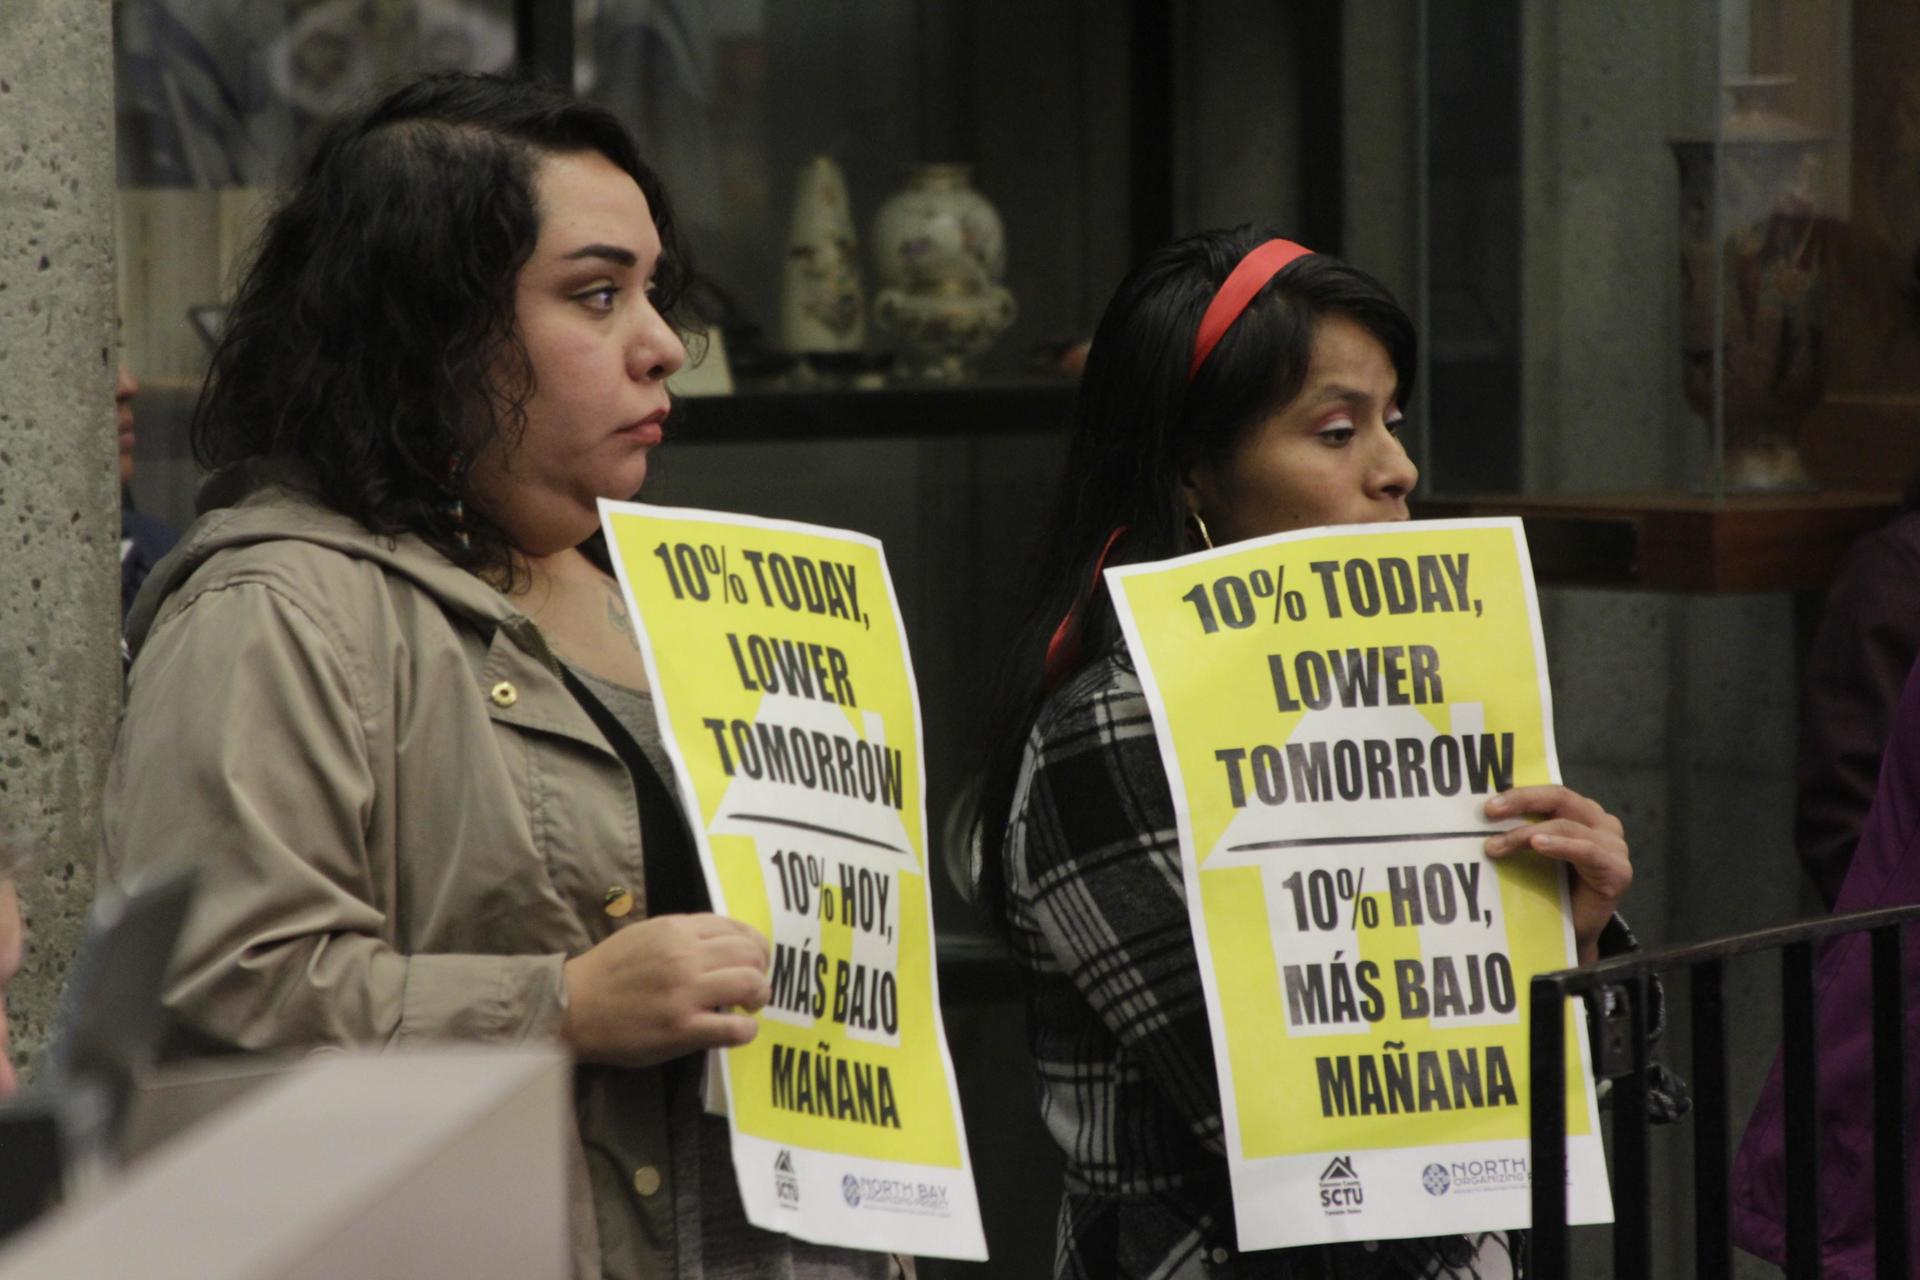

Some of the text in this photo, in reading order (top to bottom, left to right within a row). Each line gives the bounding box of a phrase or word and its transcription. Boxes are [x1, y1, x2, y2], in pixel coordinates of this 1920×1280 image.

[654, 541, 870, 631] 10% TODAY,
[1181, 552, 1483, 635] 10% TODAY,
[726, 632, 857, 708] LOWER
[1267, 643, 1444, 713] LOWER
[702, 717, 904, 811] TOMORROW
[1215, 731, 1514, 808] TOMORROW
[771, 849, 893, 945] 10% HOY,
[1281, 861, 1492, 932] 10% HOY,
[768, 937, 899, 1036] MÁS BAJO
[1282, 950, 1518, 1027] MÁS BAJO
[770, 1040, 903, 1131] MAÑANA
[1315, 1040, 1519, 1119] MAÑANA
[860, 1177, 949, 1201] NORTH BAY
[1319, 1186, 1364, 1208] SCTU
[1451, 1157, 1527, 1178] NORTH
